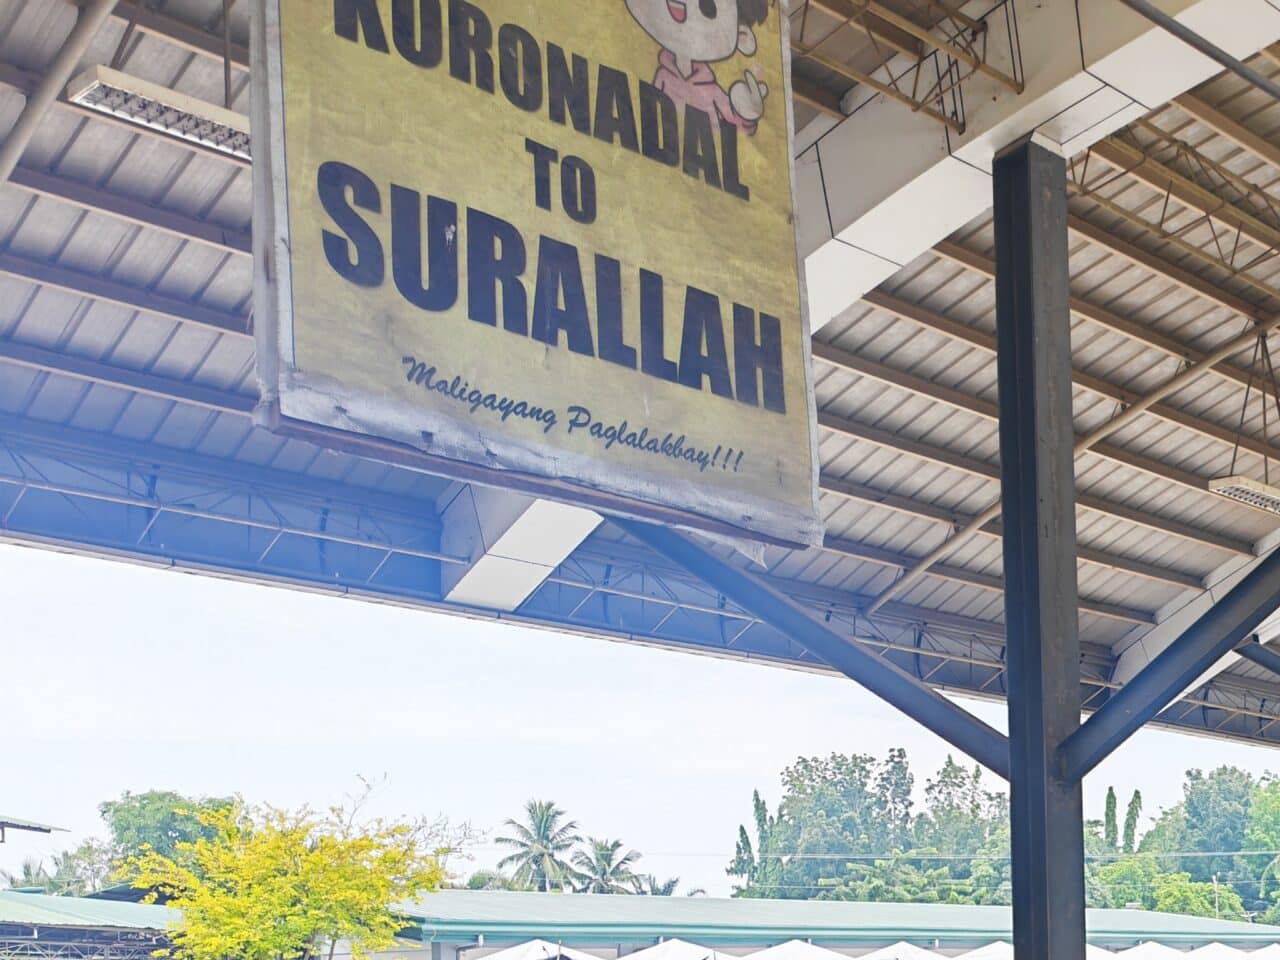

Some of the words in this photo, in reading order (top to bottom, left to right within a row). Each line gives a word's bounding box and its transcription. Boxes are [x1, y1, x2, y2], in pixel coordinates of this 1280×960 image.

[524, 138, 598, 225] TO
[316, 160, 787, 415] SURALLAH
[402, 357, 558, 434] Maligayang
[567, 405, 744, 473] Paglalakbay!!!
